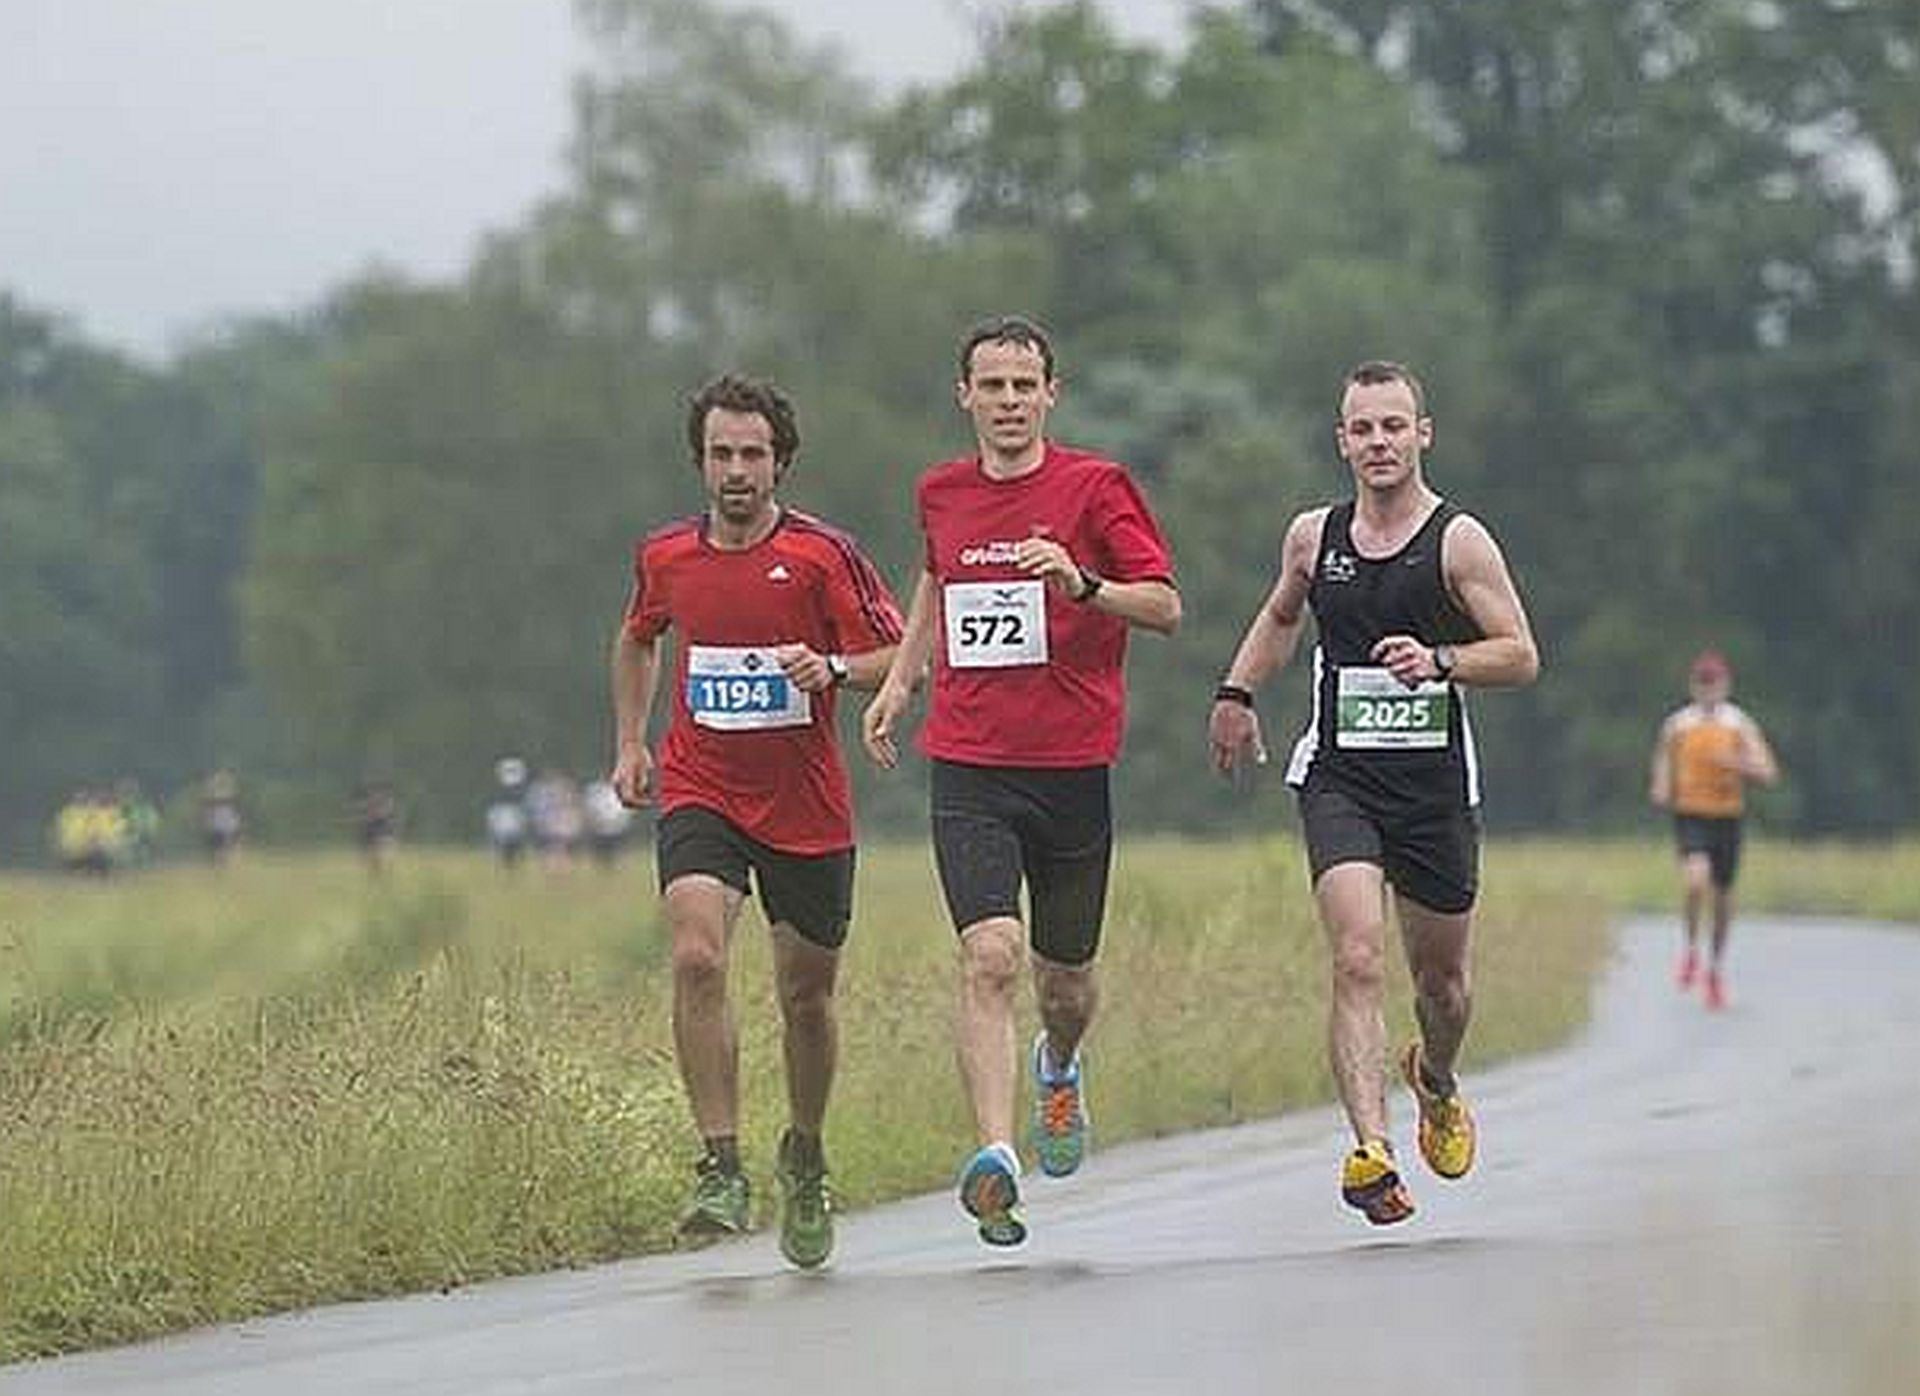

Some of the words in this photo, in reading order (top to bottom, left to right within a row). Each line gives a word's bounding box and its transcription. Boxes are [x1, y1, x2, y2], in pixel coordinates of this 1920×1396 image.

[961, 615, 1024, 645] 572
[702, 680, 771, 708] 1194
[1356, 701, 1430, 728] 2025
